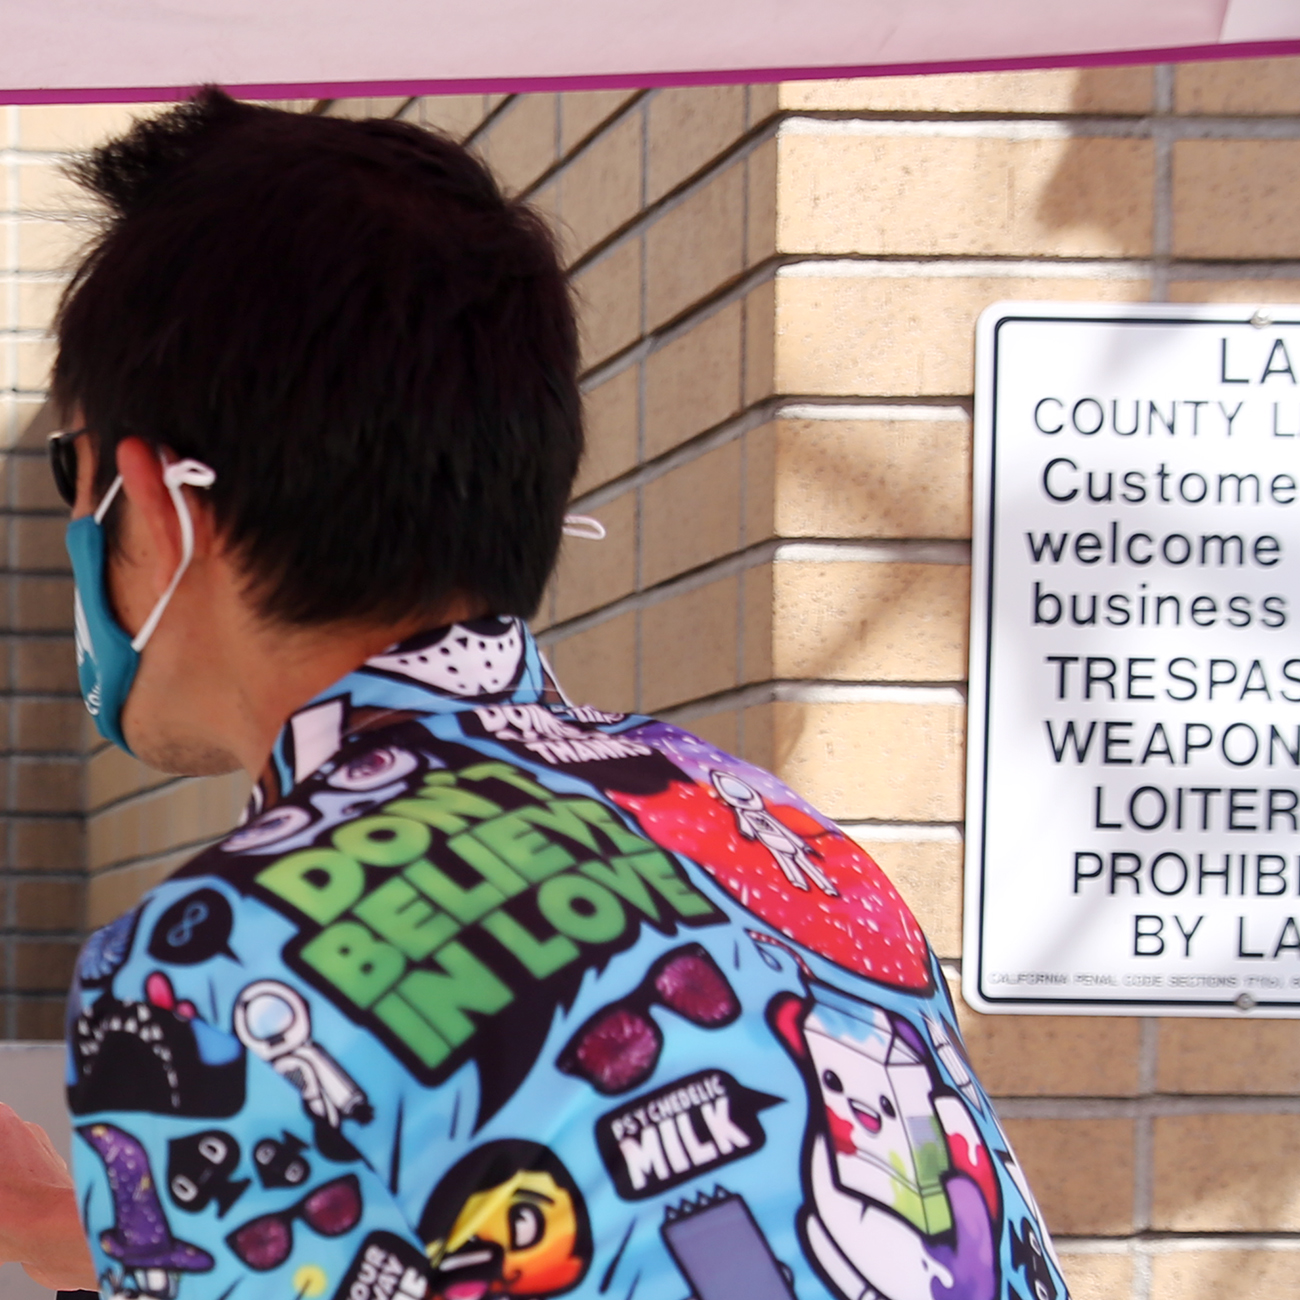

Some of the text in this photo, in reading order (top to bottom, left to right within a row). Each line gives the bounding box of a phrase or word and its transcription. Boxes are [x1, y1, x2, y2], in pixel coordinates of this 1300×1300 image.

[1220, 337, 1297, 385] LA
[1033, 397, 1243, 437] COUNTY
[1041, 457, 1297, 505] Custome
[1025, 520, 1281, 567] welcome
[1033, 581, 1287, 629] business
[1045, 655, 1300, 703] TRESPAS
[1044, 719, 1300, 767] WEAPON
[1095, 785, 1300, 832] LOITER
[373, 850, 716, 1069] IN LOVE
[1133, 914, 1300, 960] BY LA
[620, 1096, 750, 1190] MILK
